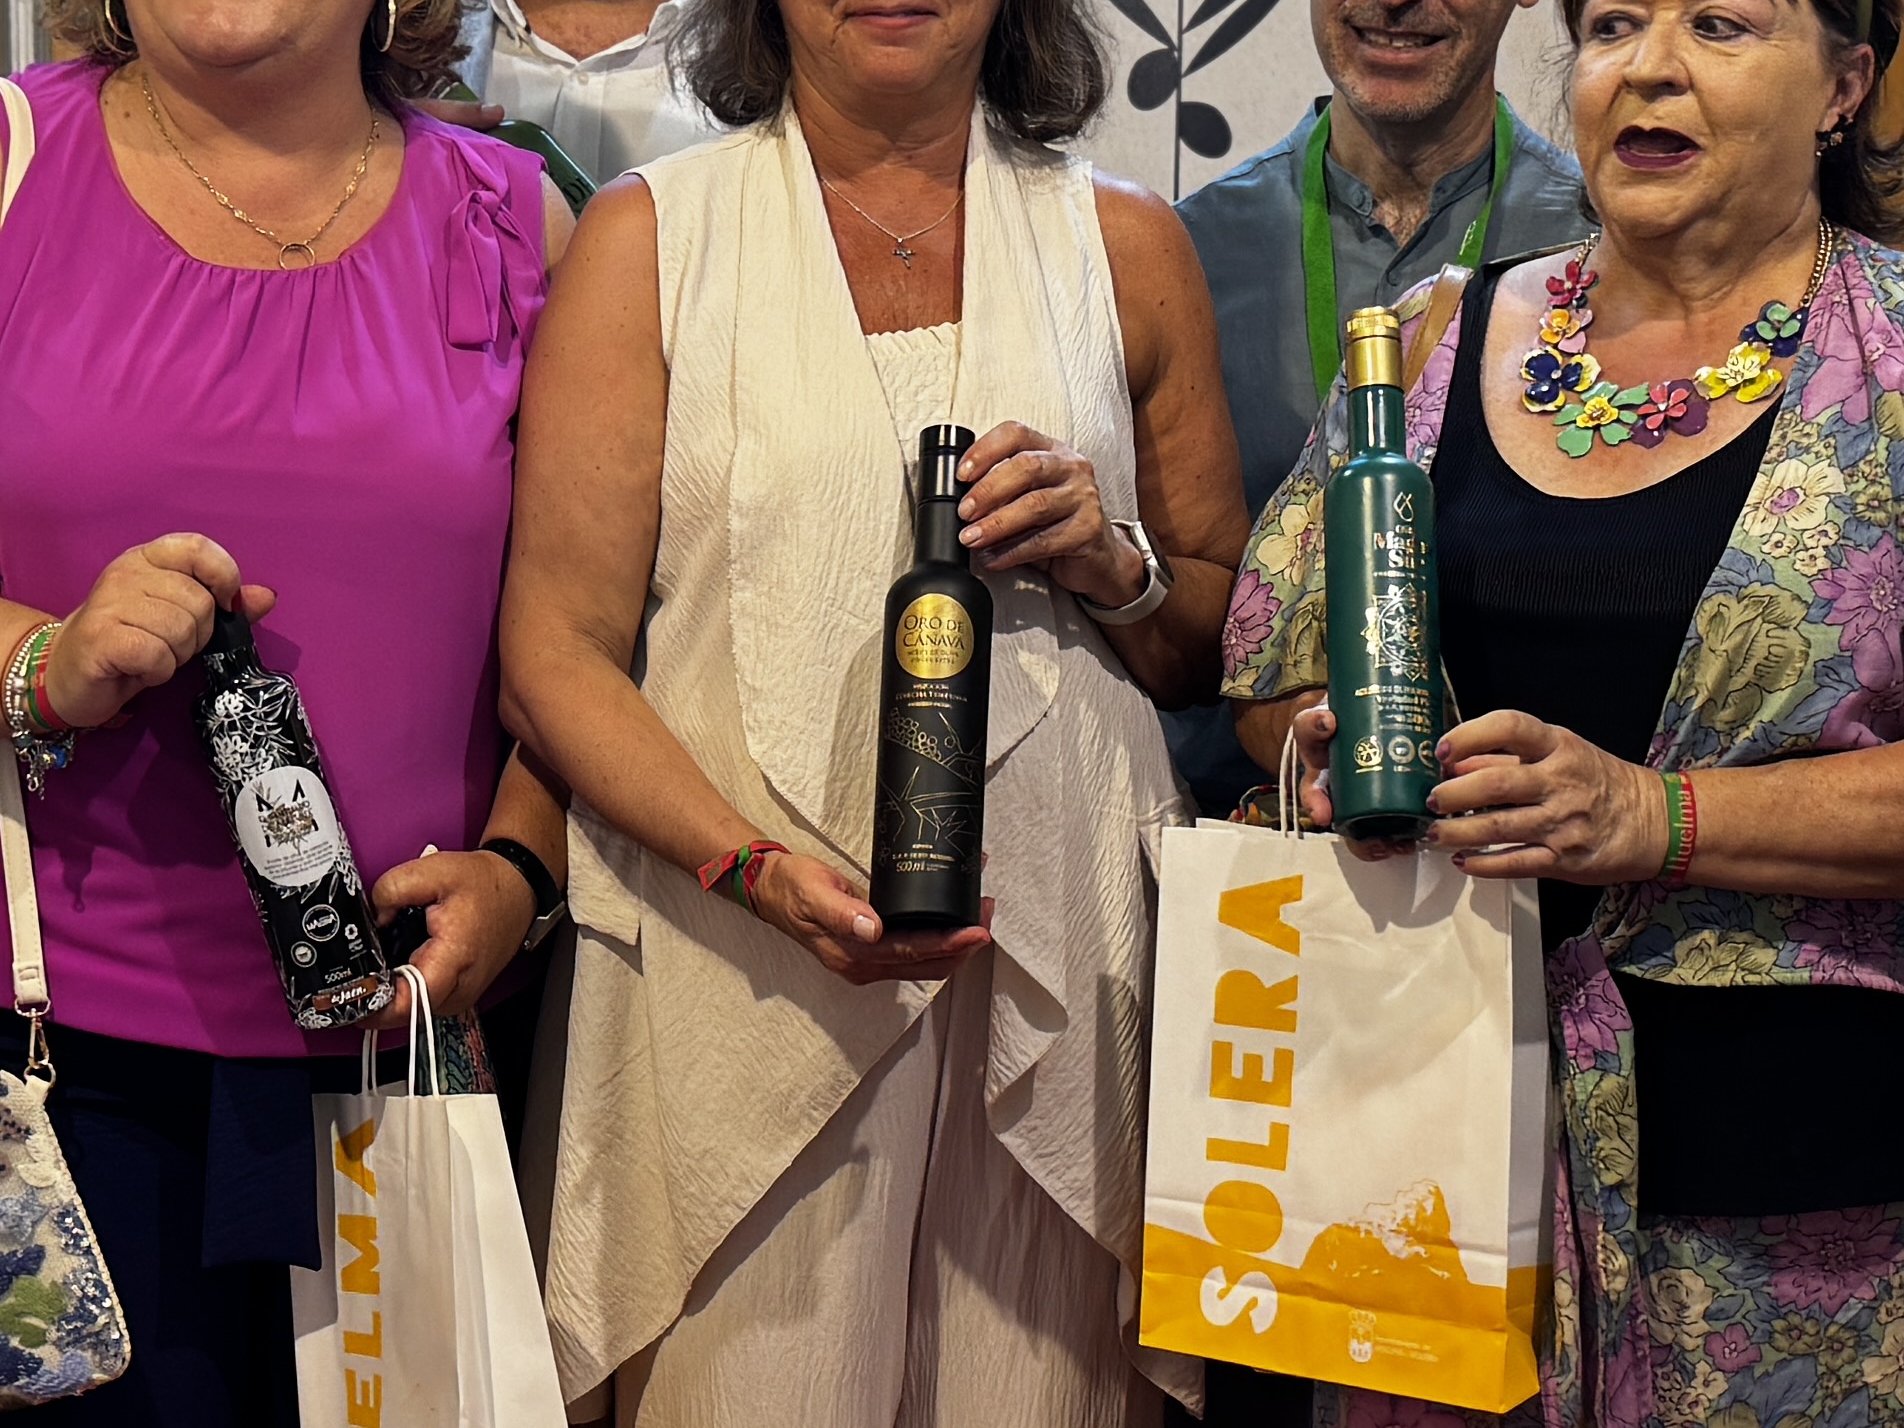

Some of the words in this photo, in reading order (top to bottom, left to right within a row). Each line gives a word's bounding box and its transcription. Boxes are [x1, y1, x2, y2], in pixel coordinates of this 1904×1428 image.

[904, 615, 942, 630] ORO
[947, 619, 965, 632] DE
[1199, 874, 1305, 1336] SOLERA
